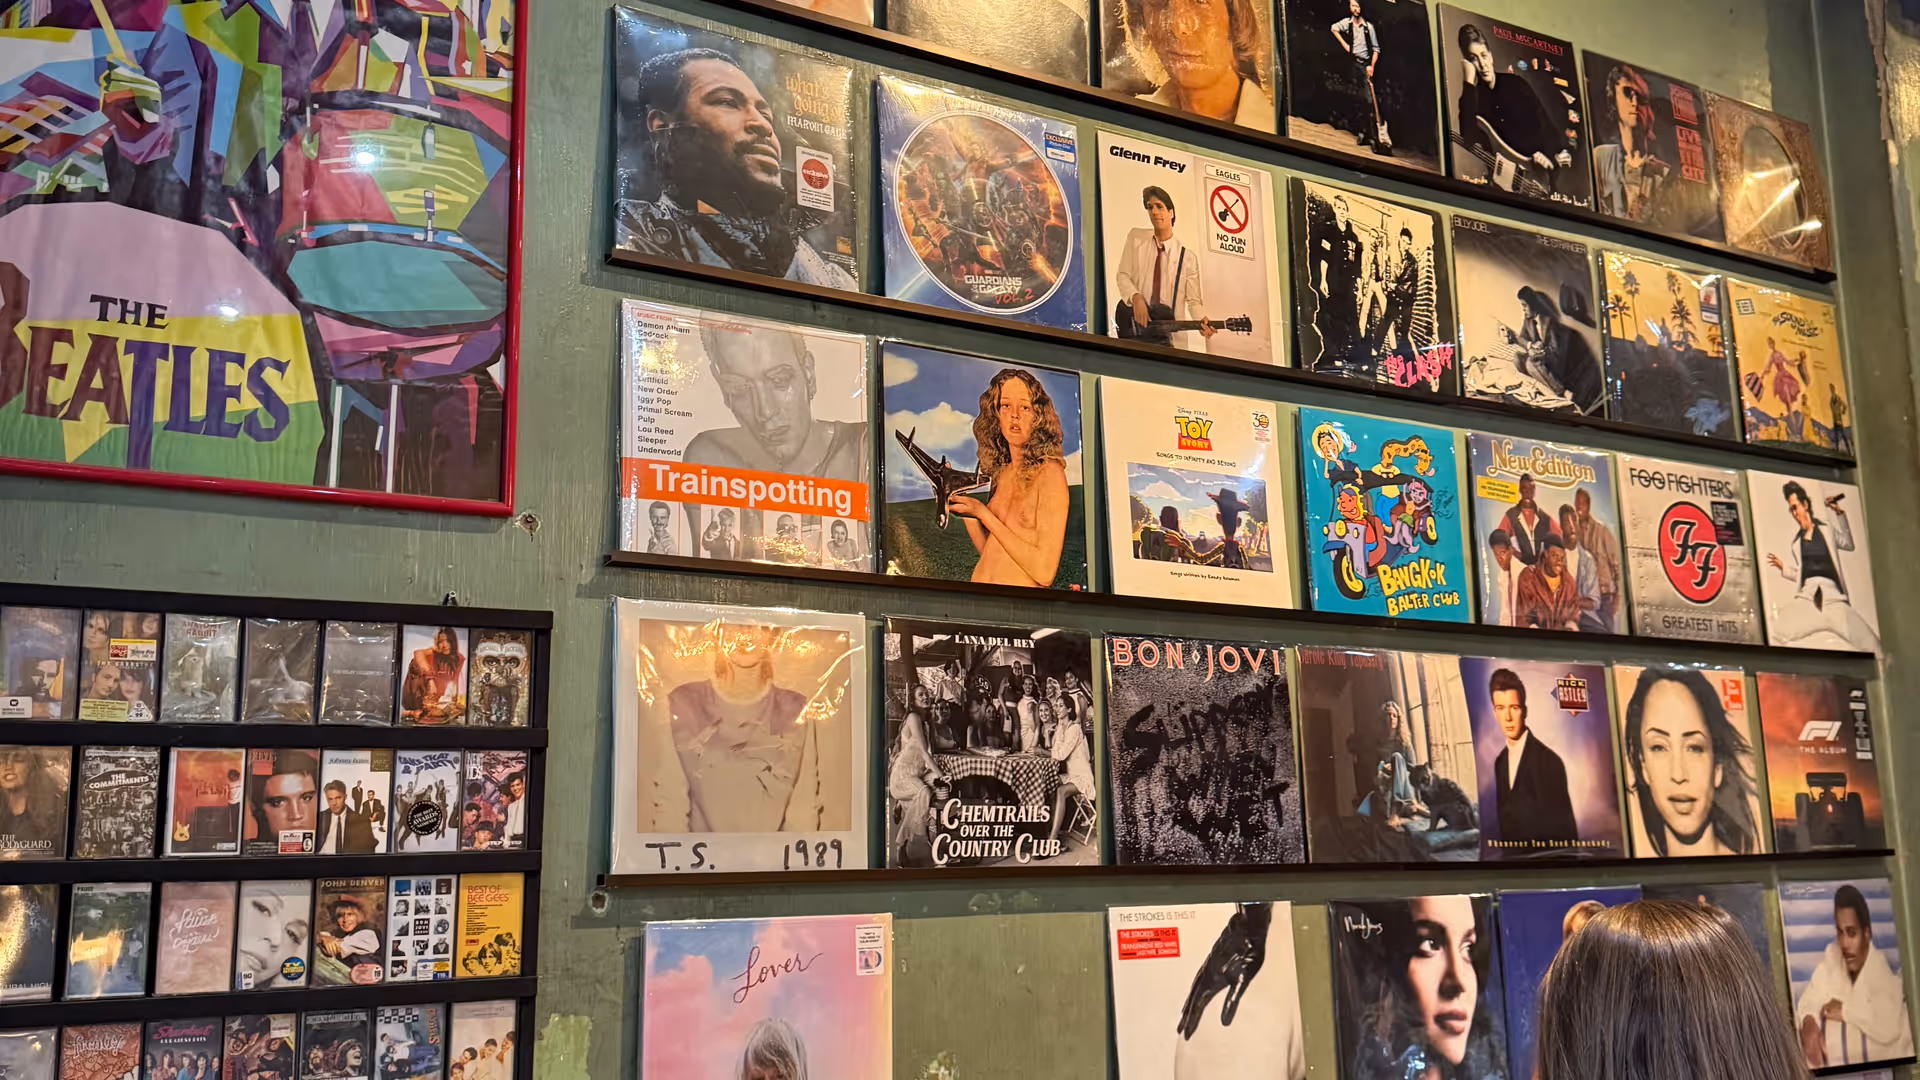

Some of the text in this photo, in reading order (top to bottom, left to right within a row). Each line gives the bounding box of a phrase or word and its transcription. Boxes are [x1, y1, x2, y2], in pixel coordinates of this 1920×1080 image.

[1492, 25, 1512, 39] PAUL
[793, 92, 830, 120] going
[1044, 133, 1075, 146] EXCLUSIVE
[1109, 145, 1187, 174] Glenn Frey
[802, 168, 829, 180] exclusive
[1215, 168, 1241, 182] EAGLES
[1454, 216, 1491, 234] BILLY JOEL
[1216, 232, 1247, 247] NO FUN
[1219, 242, 1245, 254] ALOUD
[964, 274, 1022, 286] GUARDIANS
[979, 284, 1021, 295] GALAXY
[1024, 288, 1034, 301] 2
[89, 293, 169, 330] THE
[637, 320, 664, 331] Damon
[1394, 341, 1454, 388] CLASH
[637, 385, 679, 397] New Order
[637, 396, 672, 407] Iggy Pop
[637, 405, 693, 418] Primal Scream
[637, 415, 656, 425] Pulp
[637, 425, 674, 436] Lou Reed
[1174, 415, 1213, 440] TOY
[637, 435, 668, 446] Sleeper
[1181, 439, 1209, 449] STORY
[637, 445, 682, 457] Underworld
[1156, 451, 1174, 459] SONGS
[1183, 455, 1205, 464] INFINITY
[1217, 459, 1237, 468] BEYOND
[1487, 439, 1597, 490] New Edition
[649, 462, 852, 517] Trainspotting
[1629, 467, 1734, 500] FOO FIGHTERS
[1376, 556, 1447, 598] BANGKOK
[1386, 591, 1461, 617] BALTER CLUB
[1661, 613, 1739, 634] GREATEST HITS
[186, 629, 218, 637] RABBIT
[954, 631, 1037, 649] LANA DEL REY
[1112, 638, 1281, 684] BON JOVI
[1557, 678, 1586, 689] RICK
[1558, 687, 1588, 704] ASTLEY
[1799, 745, 1848, 755] THE ALBUM
[401, 765, 412, 774] &
[88, 776, 150, 789] COMMITMENTS
[940, 797, 1051, 830] CHEMTRAILS
[959, 824, 1015, 838] OVER THE
[784, 838, 843, 871] 1989
[931, 832, 1062, 866] COUNTRY CLUB
[320, 878, 385, 888] JOHN DENVER
[467, 884, 502, 894] BEST OF
[467, 893, 510, 903] BEE GEES
[1119, 910, 1196, 922] THE STROKES IS THIS IT
[1120, 930, 1131, 938] THE
[730, 945, 824, 1004] Lover
